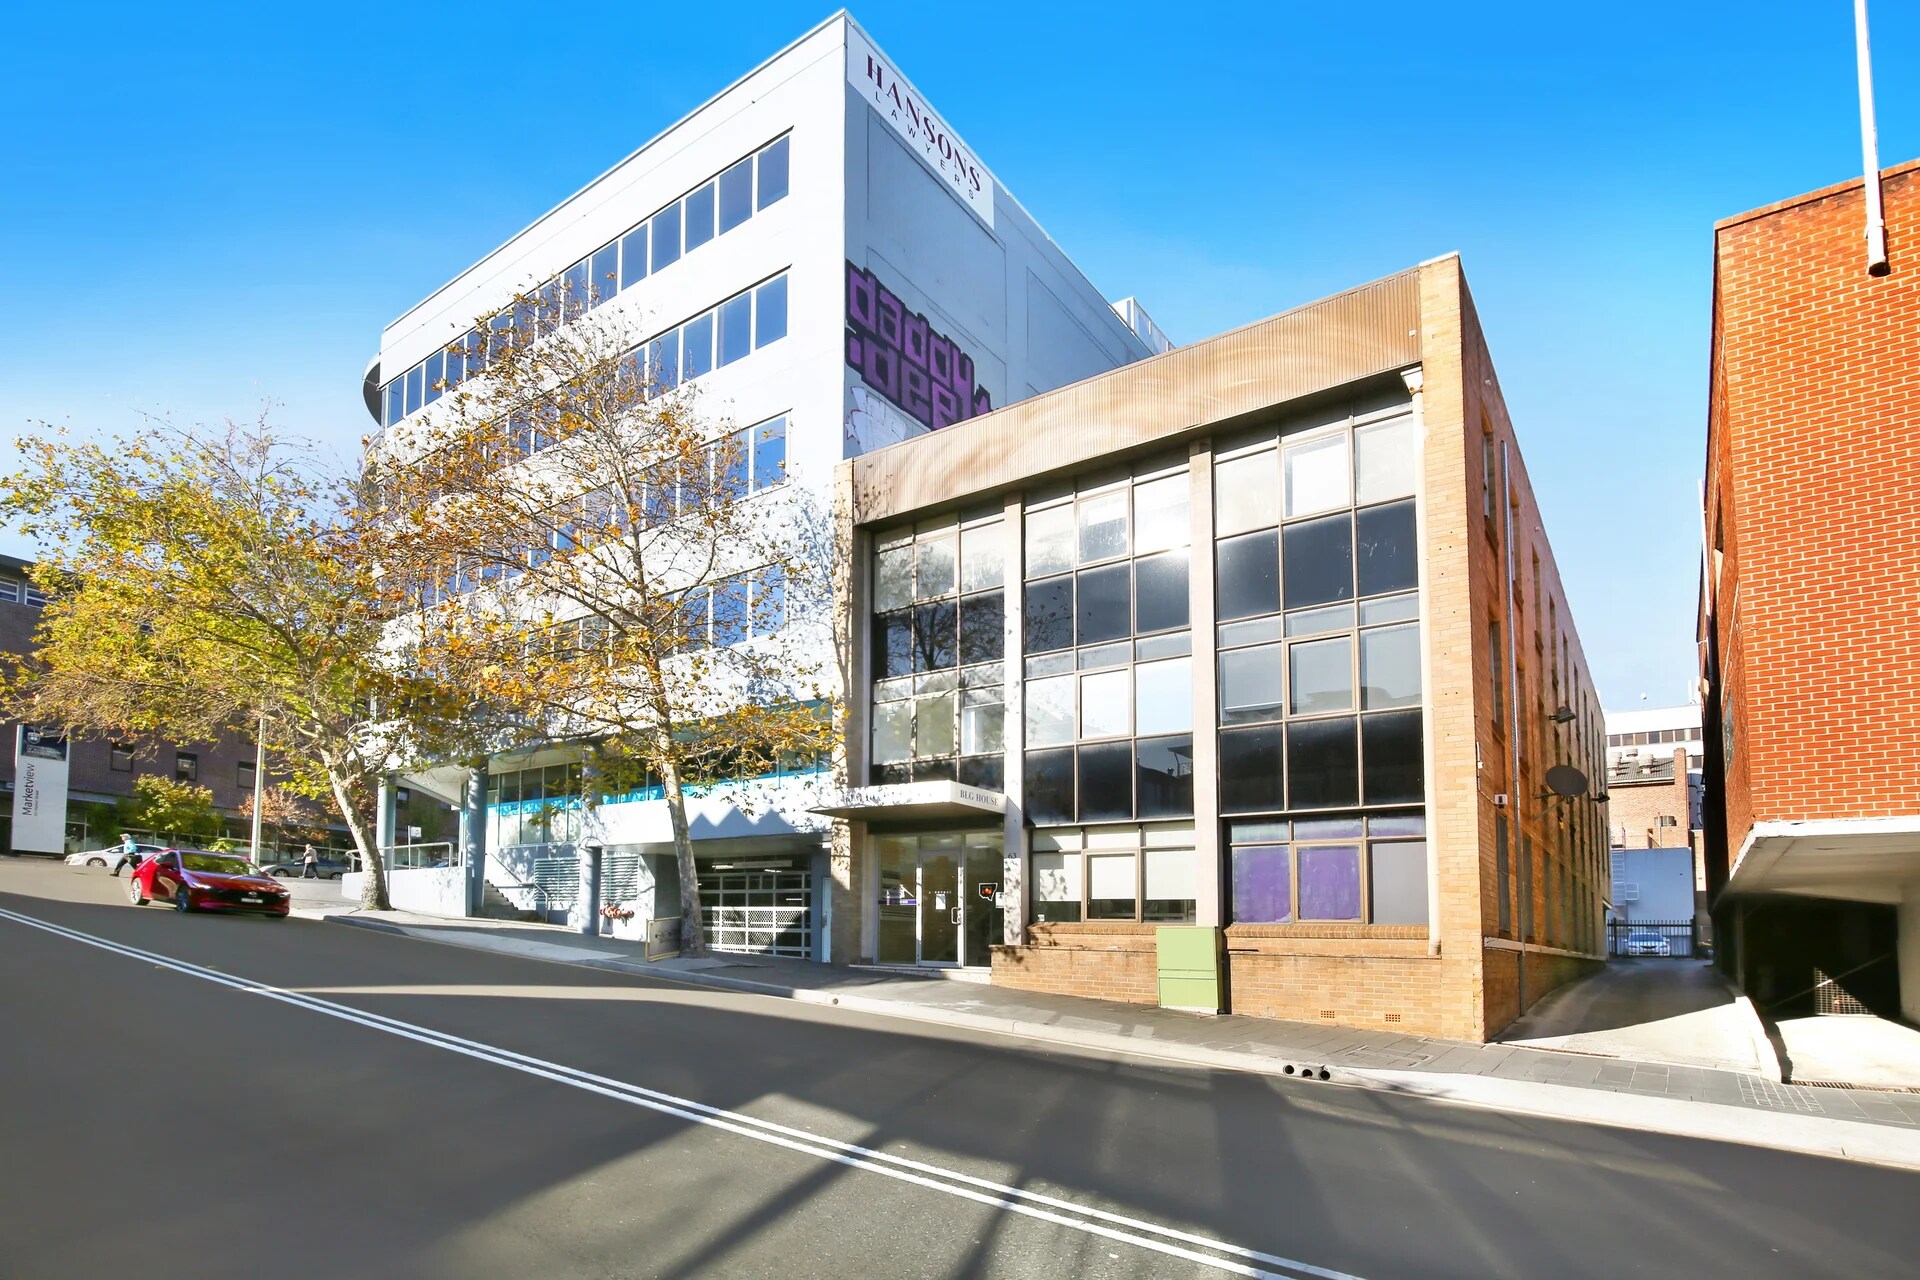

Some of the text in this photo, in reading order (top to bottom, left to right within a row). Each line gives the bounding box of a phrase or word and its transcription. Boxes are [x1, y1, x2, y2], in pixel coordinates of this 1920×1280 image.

[867, 53, 981, 192] HANSONS
[875, 91, 974, 200] LAWYERS
[22, 763, 36, 816] Marketview
[960, 790, 999, 806] BLG HOUSE
